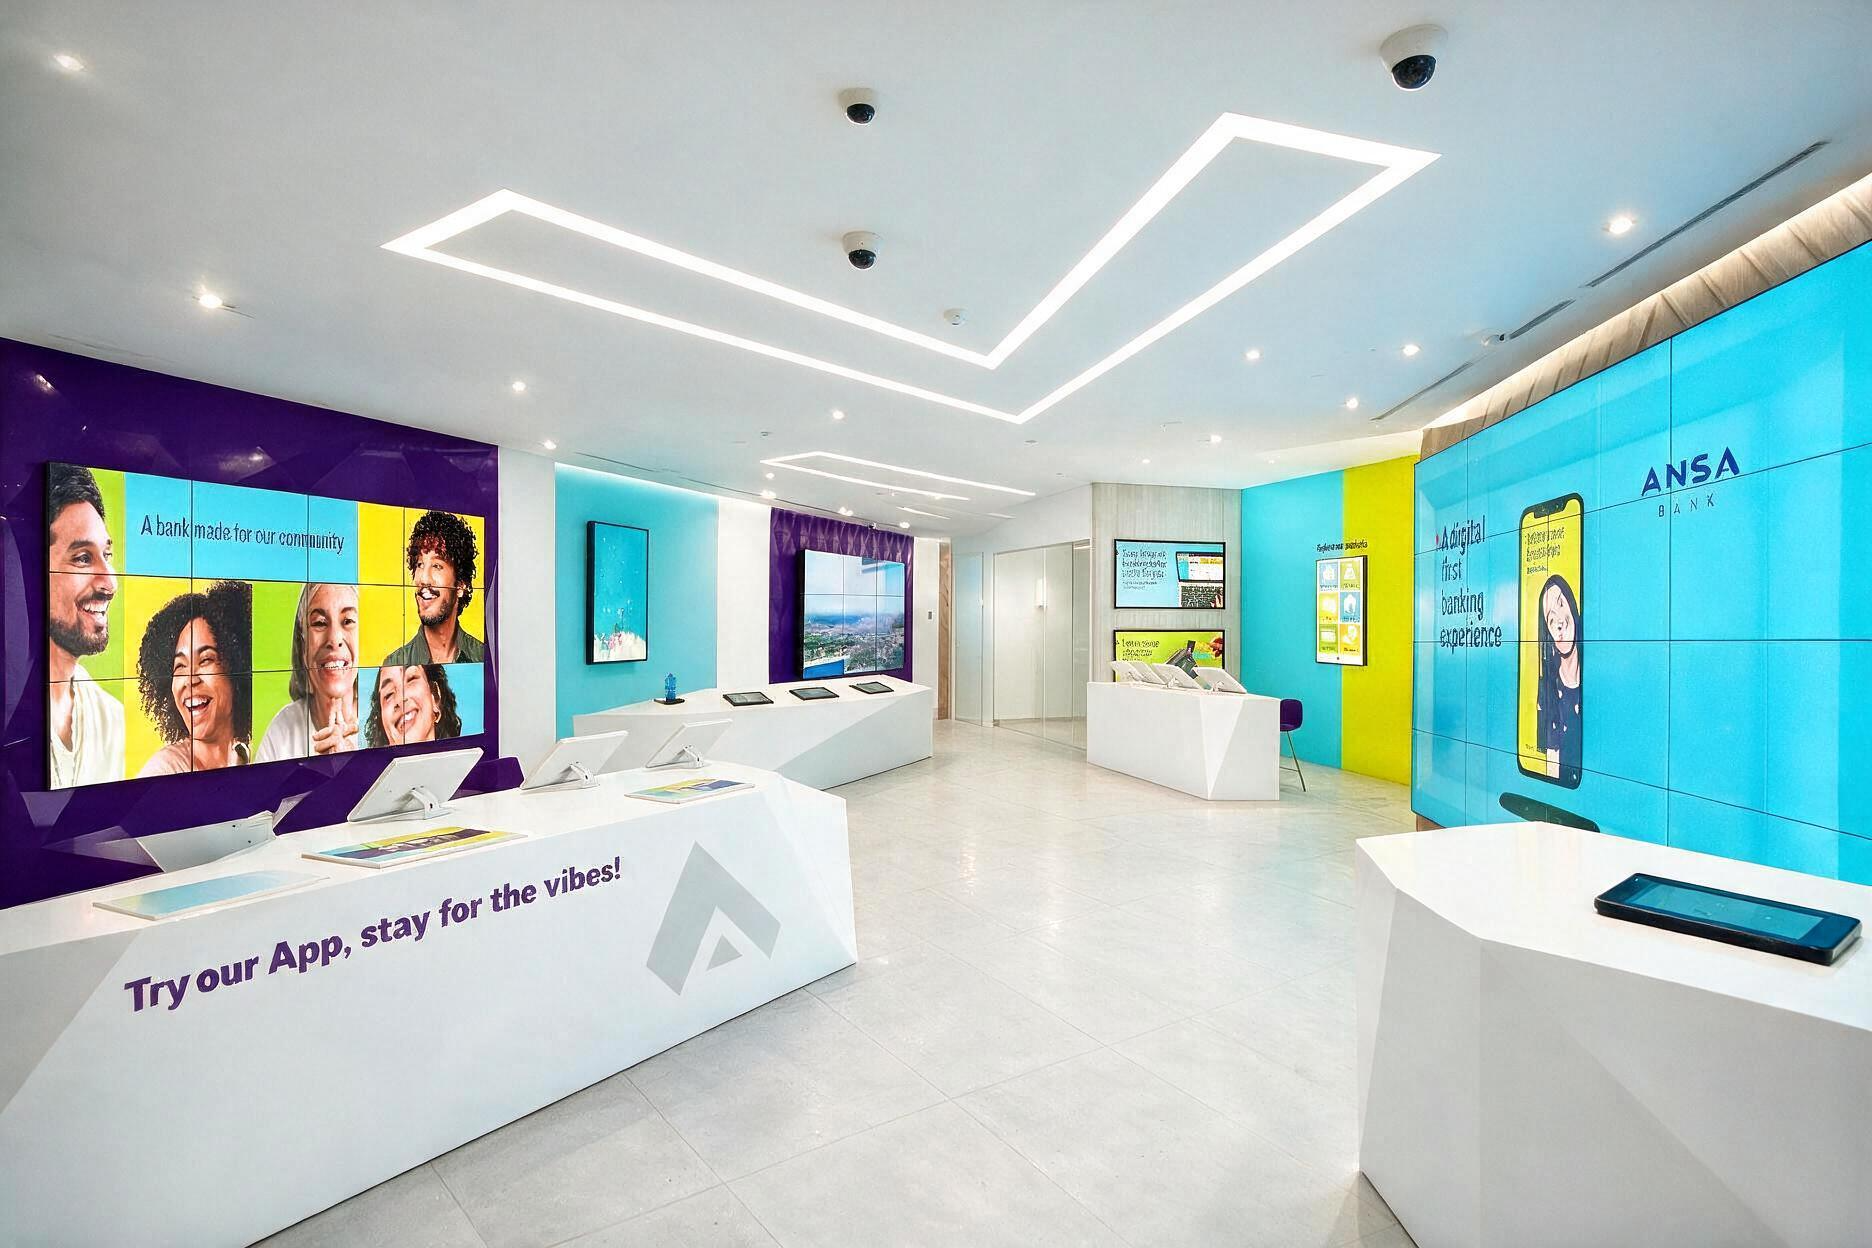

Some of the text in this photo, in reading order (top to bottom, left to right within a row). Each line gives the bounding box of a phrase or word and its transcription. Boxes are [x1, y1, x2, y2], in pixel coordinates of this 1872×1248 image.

[1641, 446, 1740, 496] ANSA
[1658, 493, 1714, 517] BANK
[141, 514, 345, 555] A bank made for our community
[1441, 526, 1449, 551] A
[1450, 514, 1485, 556] digital
[1441, 556, 1462, 581] first
[1441, 587, 1484, 621] banking
[1440, 620, 1503, 655] experience
[124, 856, 622, 1011] Try our App, stay for the vibes!
